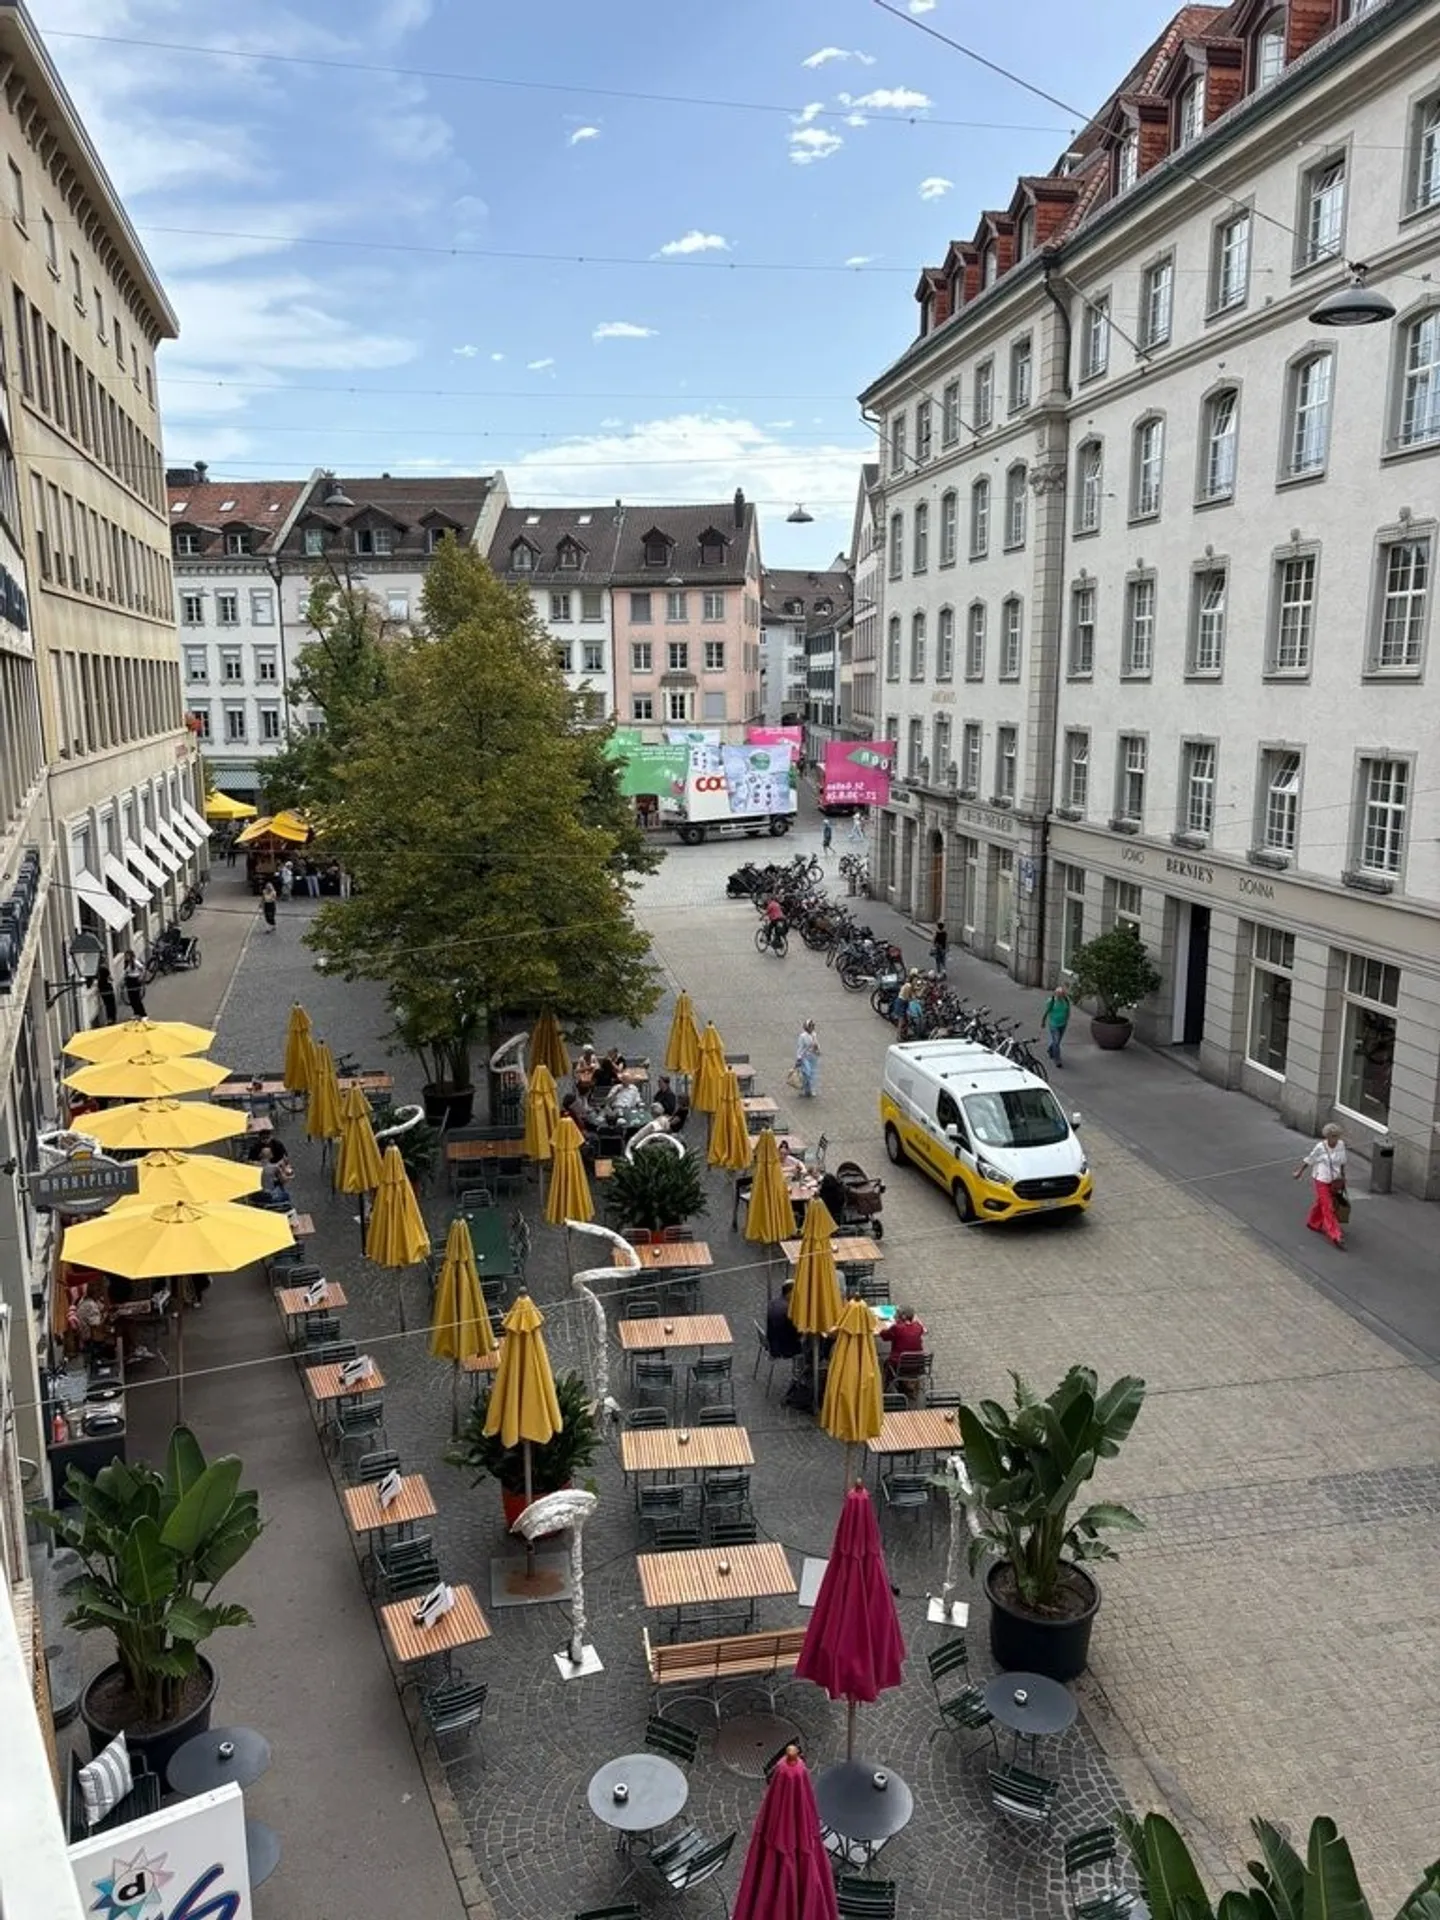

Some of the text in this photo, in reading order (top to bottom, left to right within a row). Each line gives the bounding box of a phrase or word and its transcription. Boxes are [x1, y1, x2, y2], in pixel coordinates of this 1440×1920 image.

[1121, 847, 1275, 900] UOMO BERNIE'S DONNA
